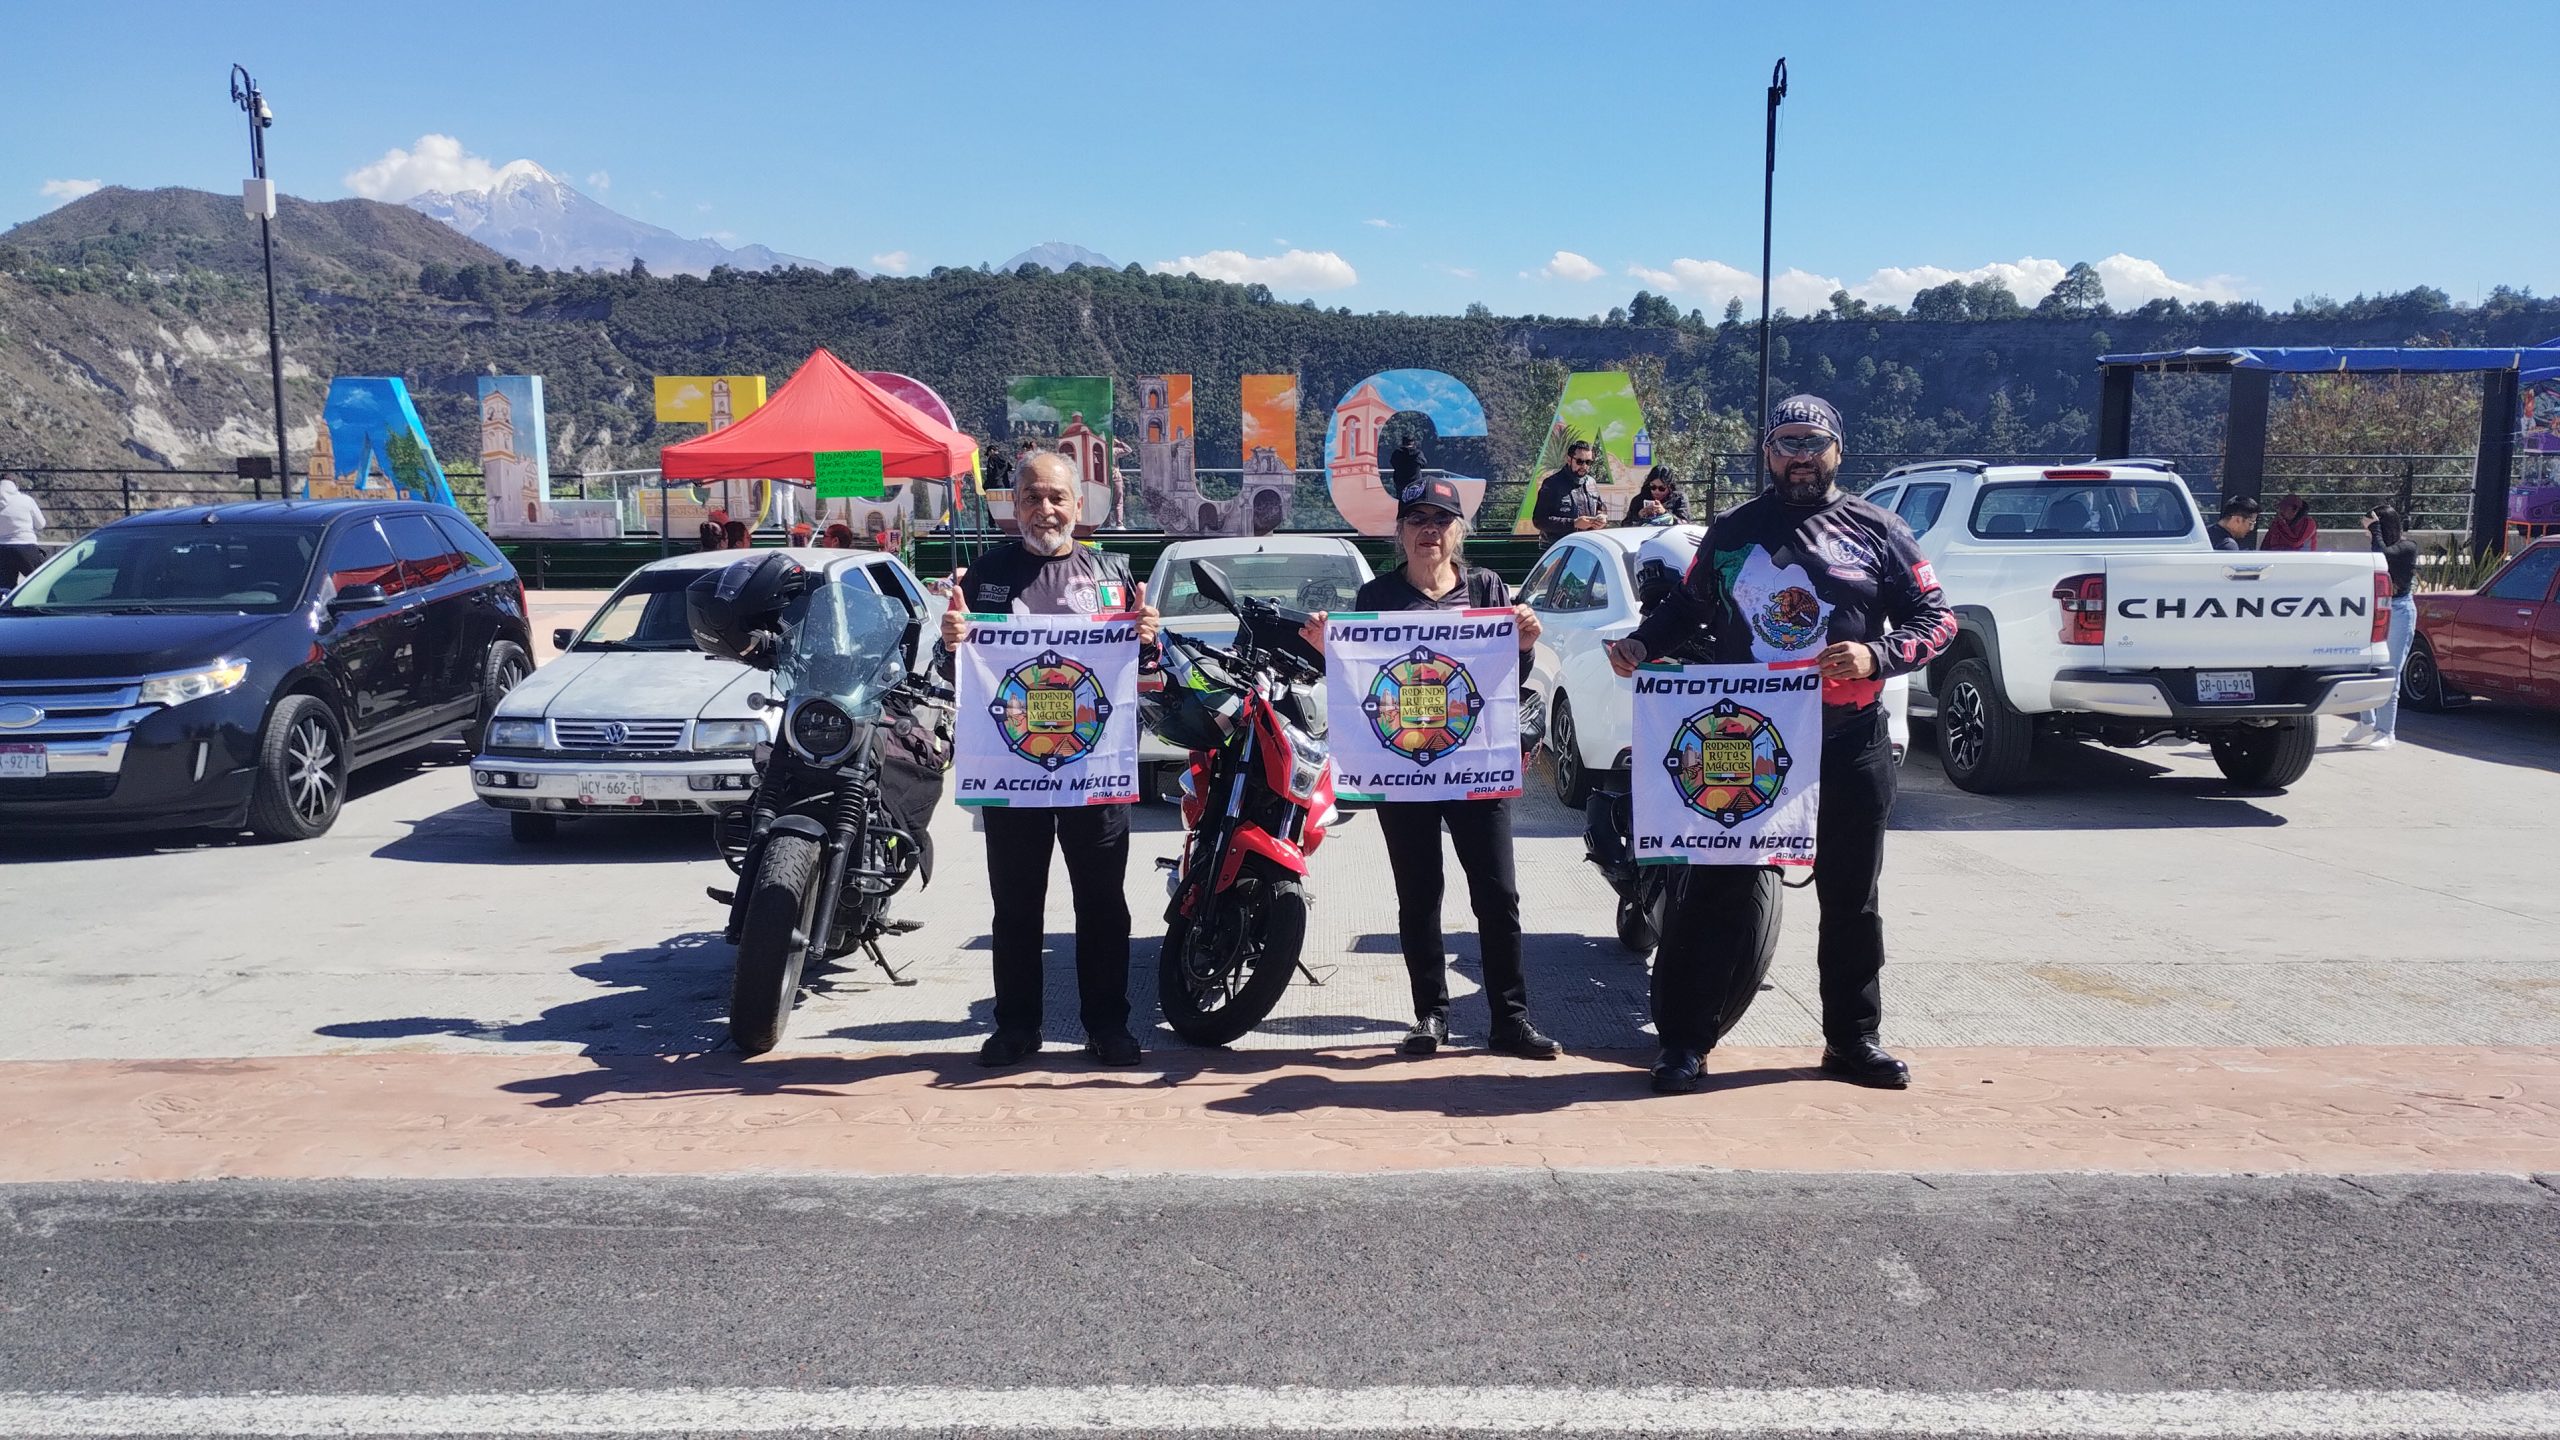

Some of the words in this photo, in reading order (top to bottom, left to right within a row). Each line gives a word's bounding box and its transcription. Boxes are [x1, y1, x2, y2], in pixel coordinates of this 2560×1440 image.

[2118, 596, 2366, 619] CHANGAN
[1330, 622, 1513, 641] MOTOTURISMO
[1044, 655, 1056, 664] N
[1415, 651, 1429, 660] N
[1636, 674, 1820, 694] MOTOTURISMO
[1470, 699, 1480, 707] E
[1099, 705, 1109, 713] E
[1720, 704, 1733, 713] N
[1419, 752, 1430, 761] S
[1047, 758, 1057, 766] S
[1778, 757, 1788, 766] E
[1338, 774, 1361, 786] EN
[1369, 769, 1436, 786] ACCIÓN
[1444, 768, 1514, 785] MÉXICO
[961, 778, 986, 790] EN
[994, 776, 1062, 791] ACCIÓN
[1069, 773, 1130, 791] MÉXICO
[582, 781, 639, 794] HCY-662-G
[1724, 813, 1735, 821] S
[1639, 836, 1663, 849] EN
[1671, 831, 1741, 849] ACCIÓN
[1750, 832, 1815, 849] MÉXICO
